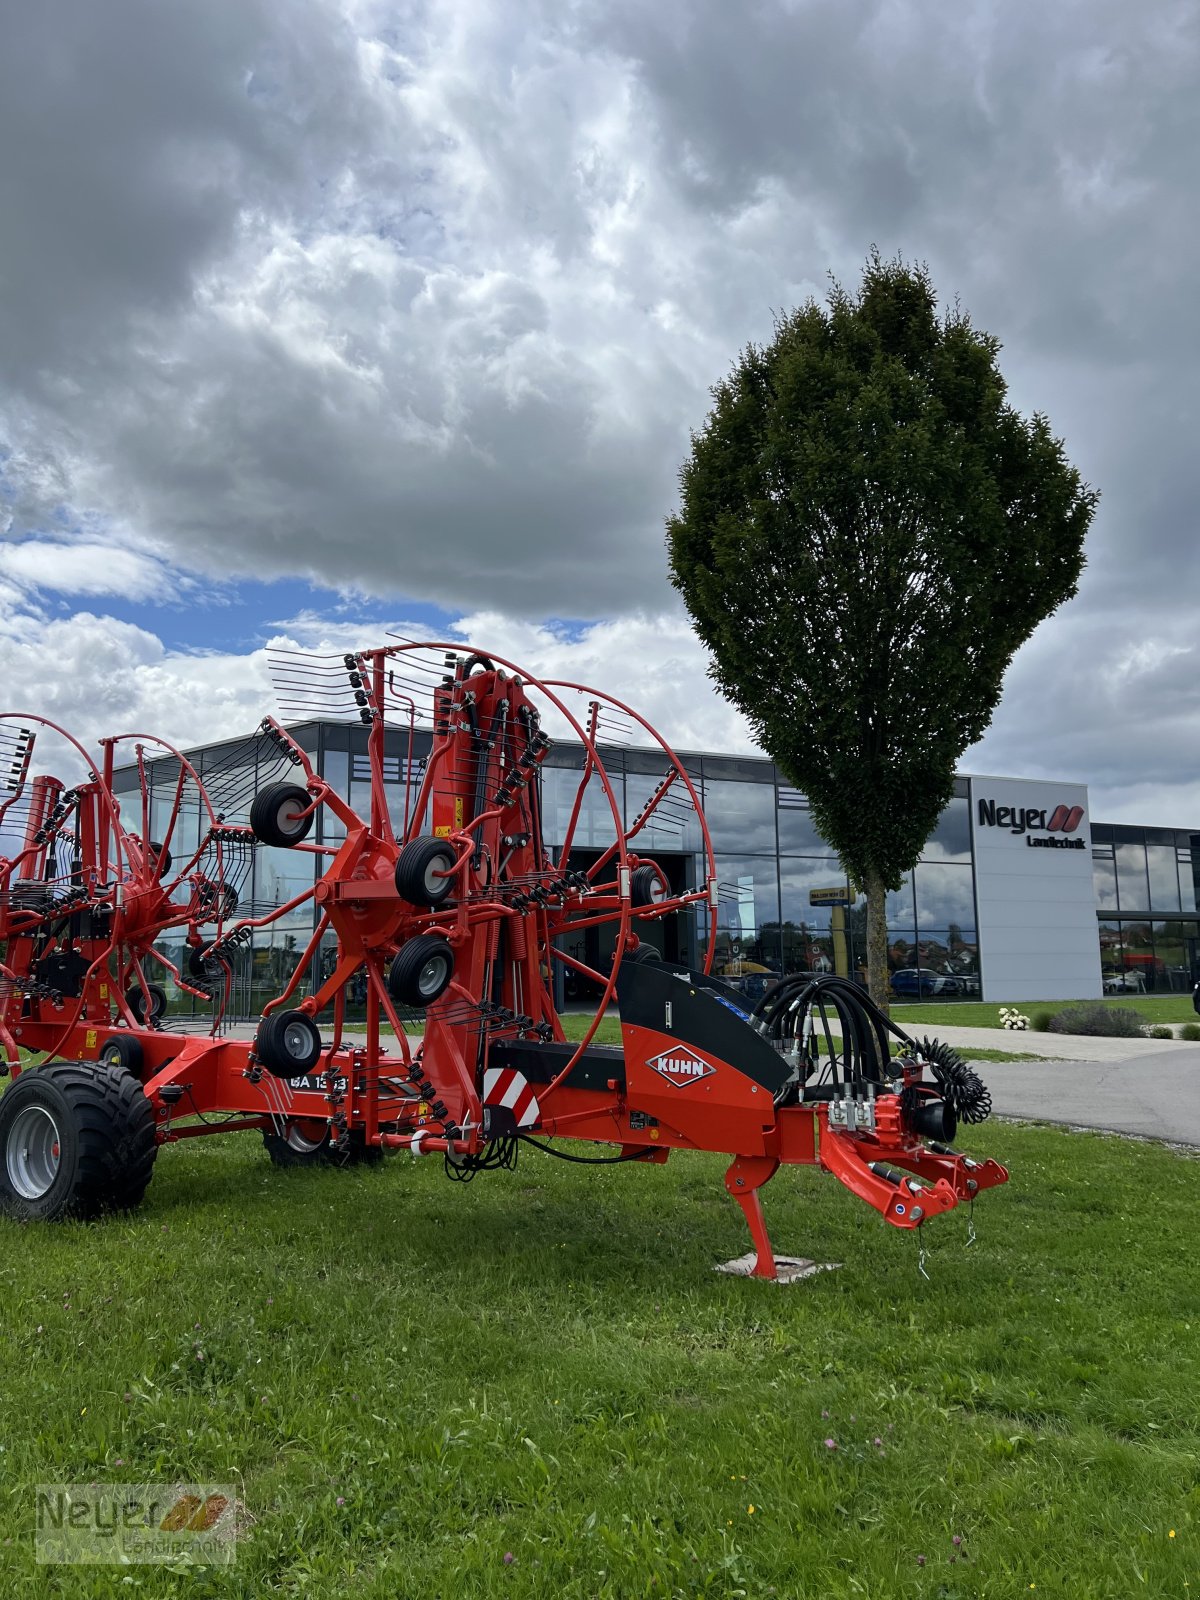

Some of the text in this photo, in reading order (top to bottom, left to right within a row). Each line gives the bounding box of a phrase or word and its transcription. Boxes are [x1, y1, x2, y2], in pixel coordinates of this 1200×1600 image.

[979, 799, 1047, 834] Neyer
[1026, 835, 1087, 849] Landtechnik
[657, 1057, 704, 1076] KUHN
